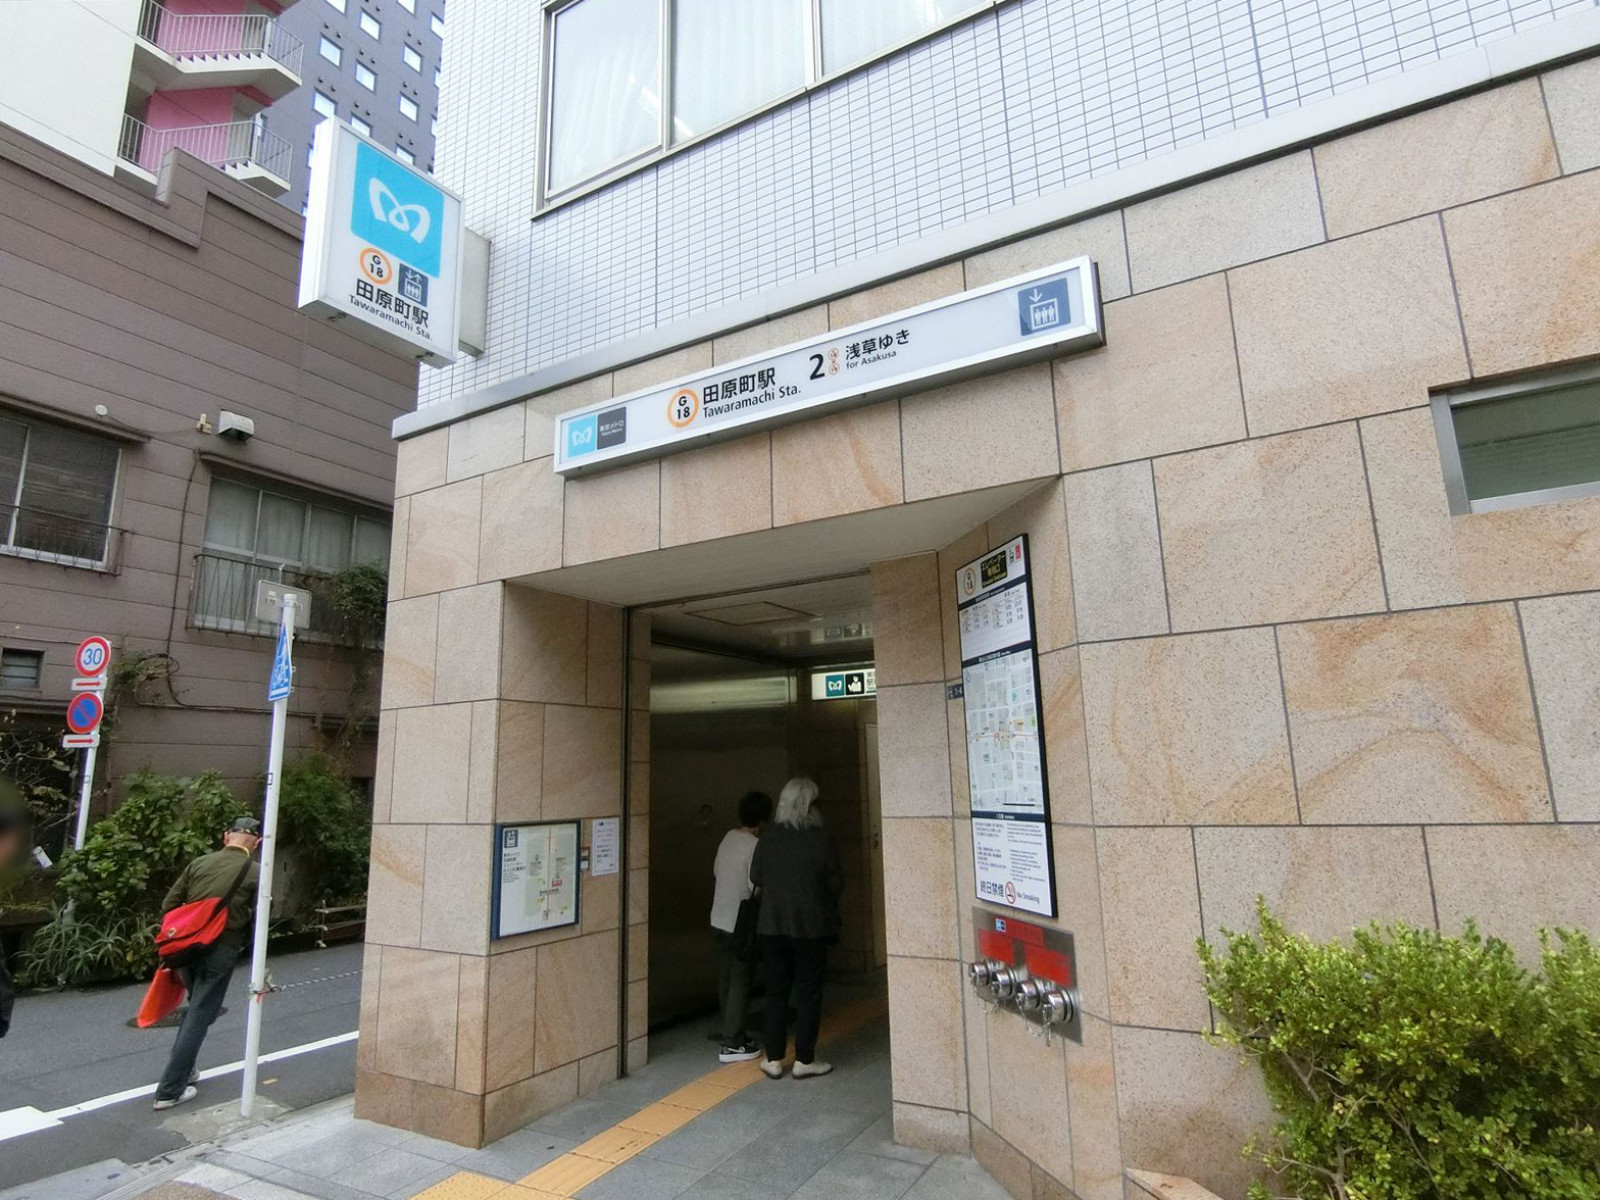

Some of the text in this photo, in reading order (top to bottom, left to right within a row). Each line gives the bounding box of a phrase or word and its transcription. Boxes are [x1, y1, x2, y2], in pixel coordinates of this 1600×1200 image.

[370, 263, 383, 278] 18
[372, 254, 381, 265] G
[356, 278, 429, 329] 田原町駅
[349, 294, 433, 341] Tawaramachi Sta.
[845, 329, 910, 361] 浅草ゆき
[809, 353, 826, 381] 2
[846, 359, 859, 370] for
[861, 350, 897, 366] Asakusa
[702, 367, 776, 406] 田原町駅
[676, 406, 691, 419] 18
[678, 395, 688, 407] G
[703, 385, 801, 418] Tawaramachi Sta.
[83, 648, 103, 665] 30
